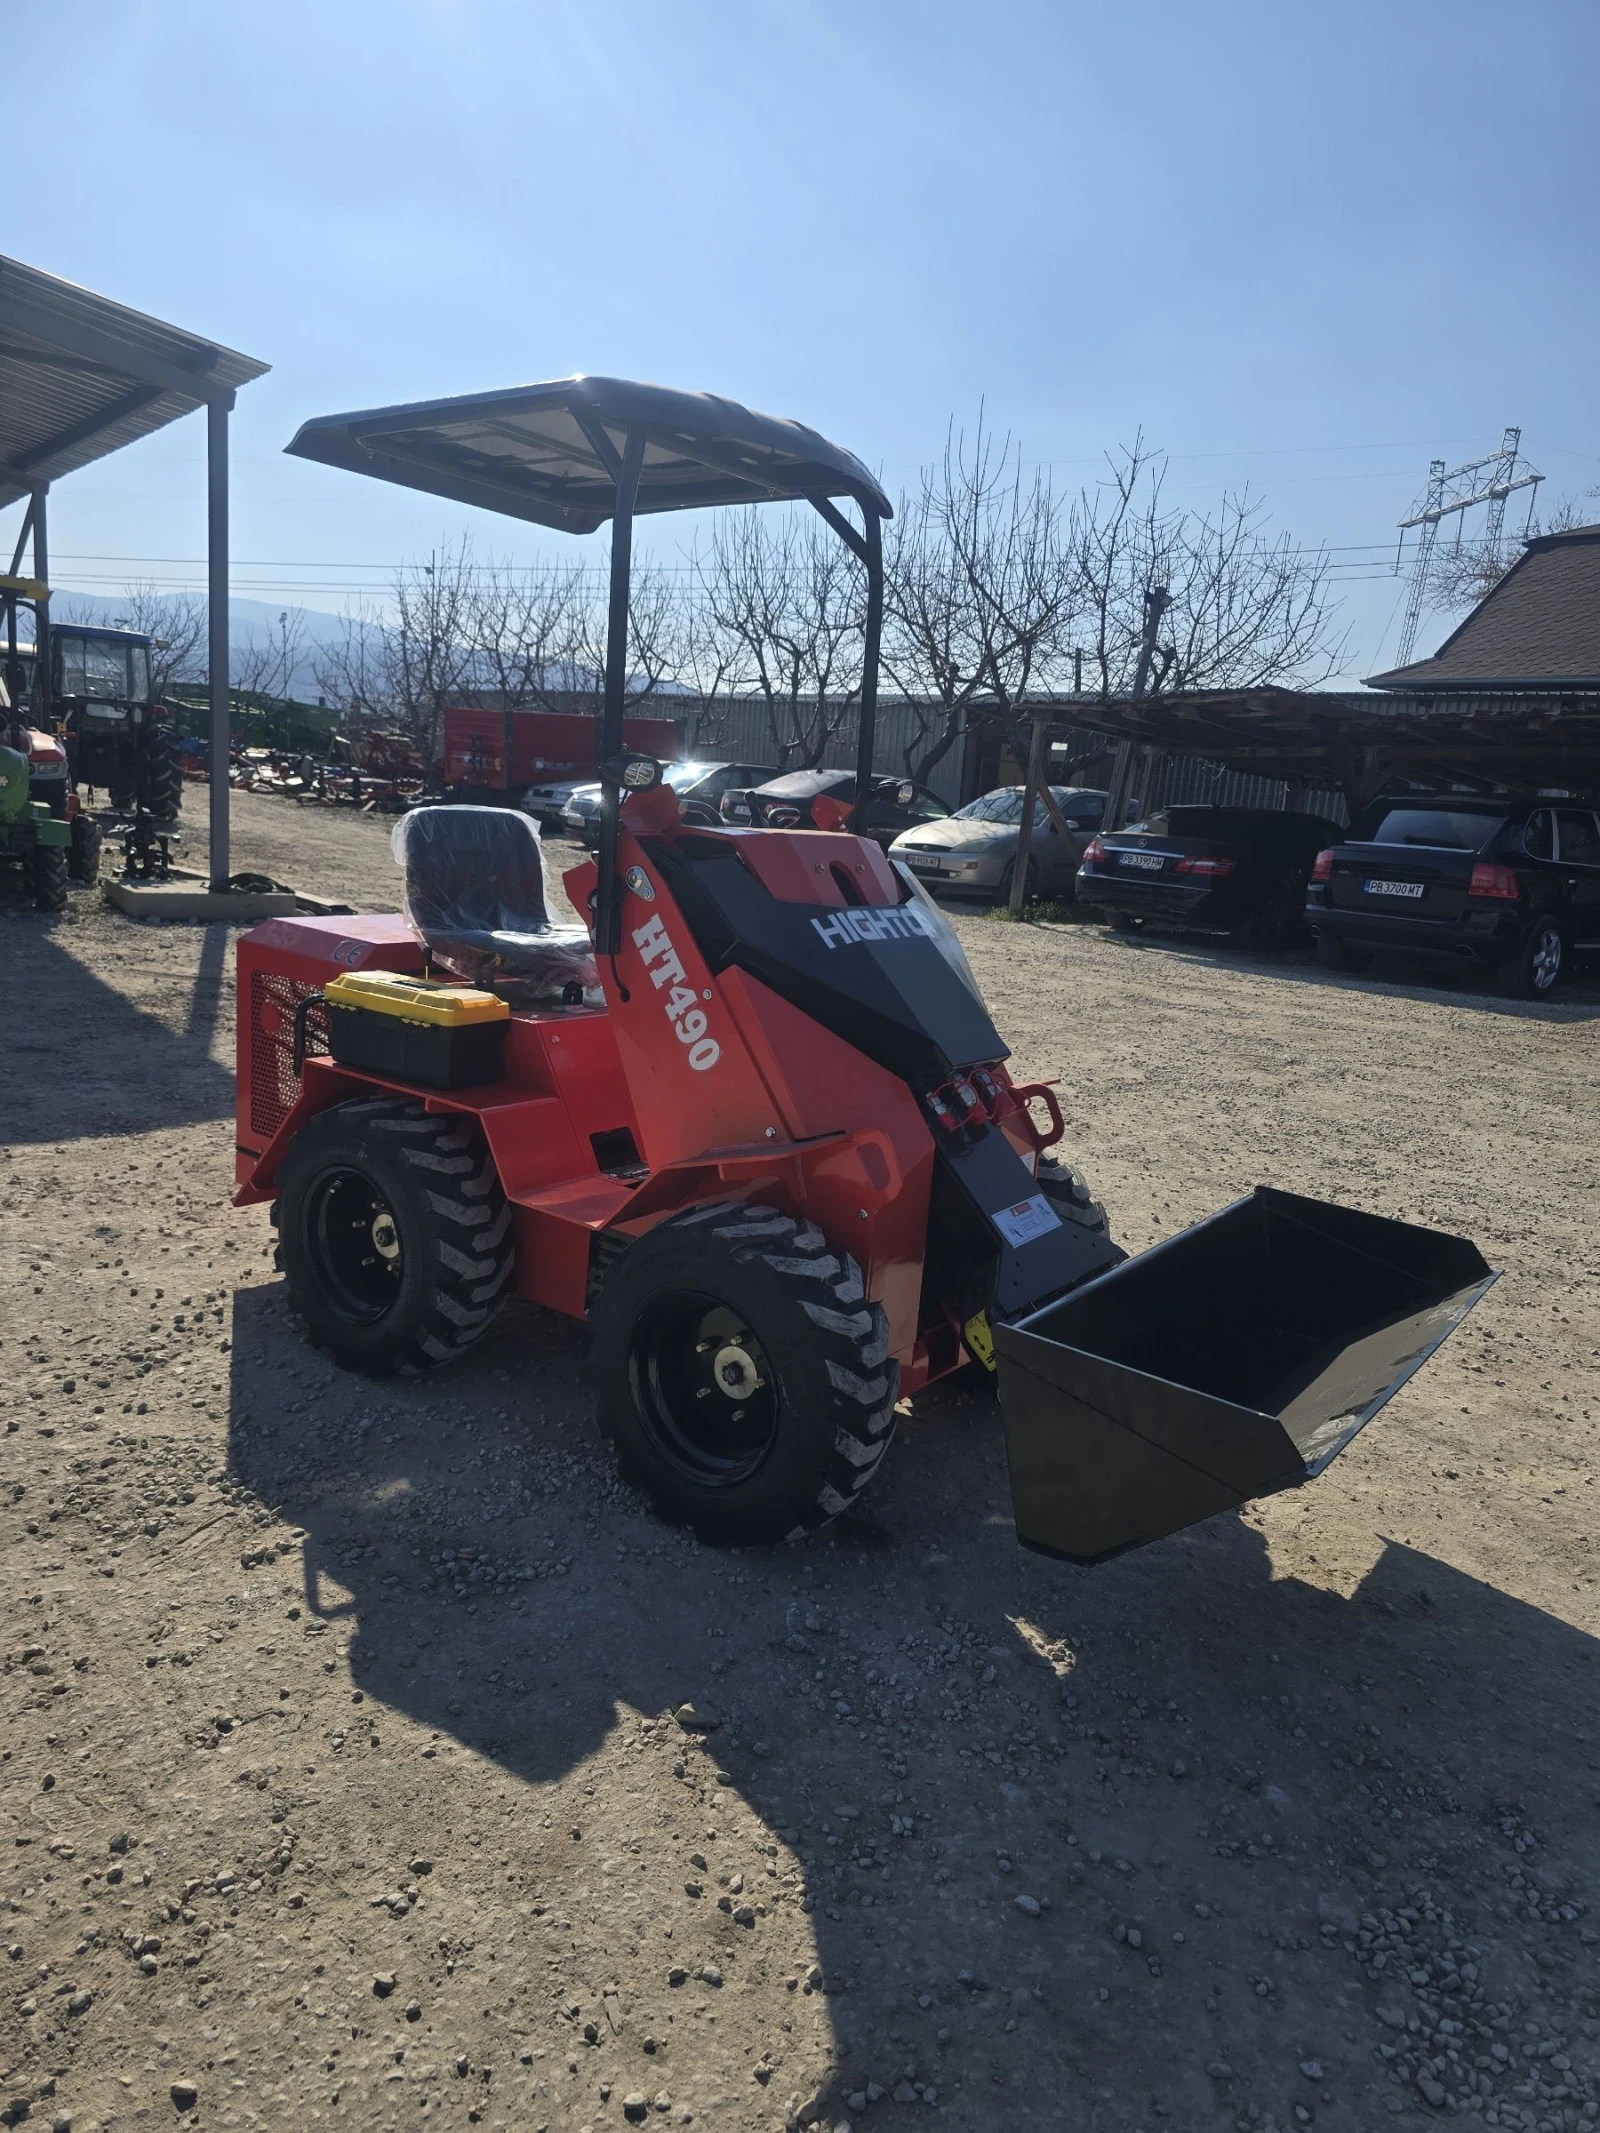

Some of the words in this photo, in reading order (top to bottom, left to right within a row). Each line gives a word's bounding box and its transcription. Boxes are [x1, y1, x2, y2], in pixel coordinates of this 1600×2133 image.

[1123, 854, 1134, 864] PB
[1134, 855, 1152, 866] 3390
[1371, 881, 1383, 893] PB
[1383, 883, 1408, 895] 3700
[631, 913, 720, 1071] HT490
